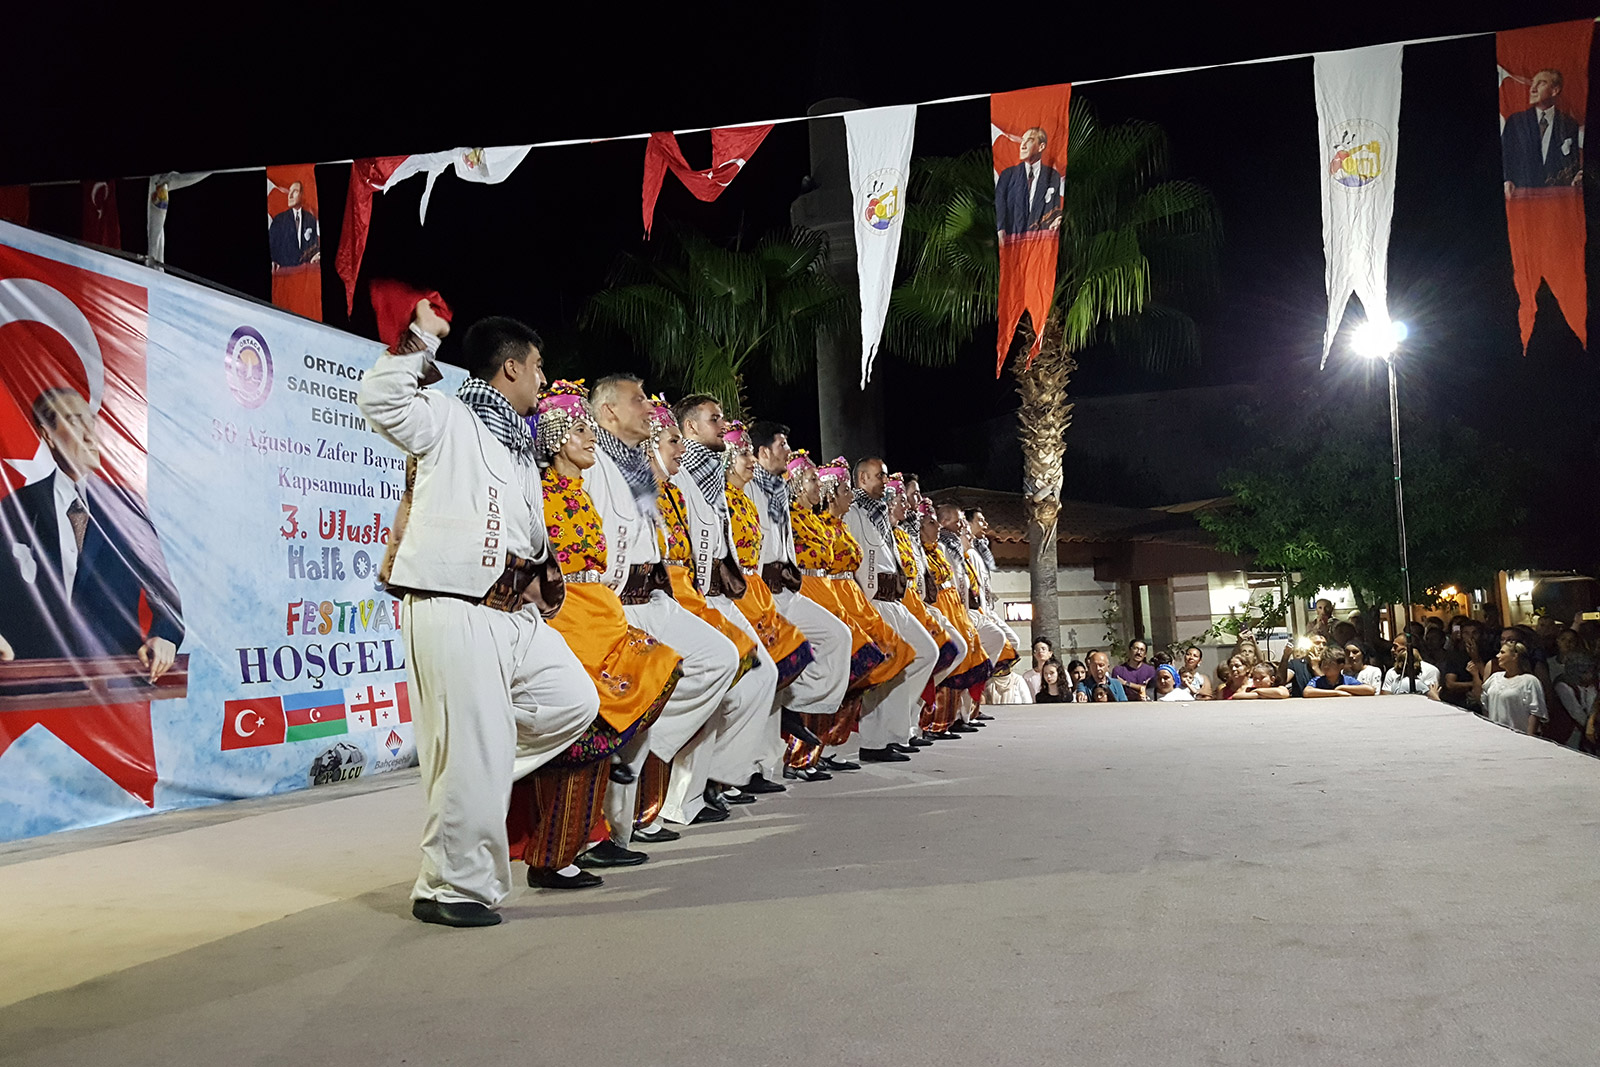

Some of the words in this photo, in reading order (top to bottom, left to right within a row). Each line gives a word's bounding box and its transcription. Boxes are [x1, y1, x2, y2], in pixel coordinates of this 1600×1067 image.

[311, 407, 366, 432] EĞİTİM
[212, 418, 237, 443] 30
[244, 425, 311, 456] Ağustos
[317, 438, 358, 463] Zafer
[278, 466, 375, 498] Kapsamında
[280, 504, 307, 540] 3.
[288, 545, 346, 581] Halk
[235, 639, 406, 689] HOŞGEL
